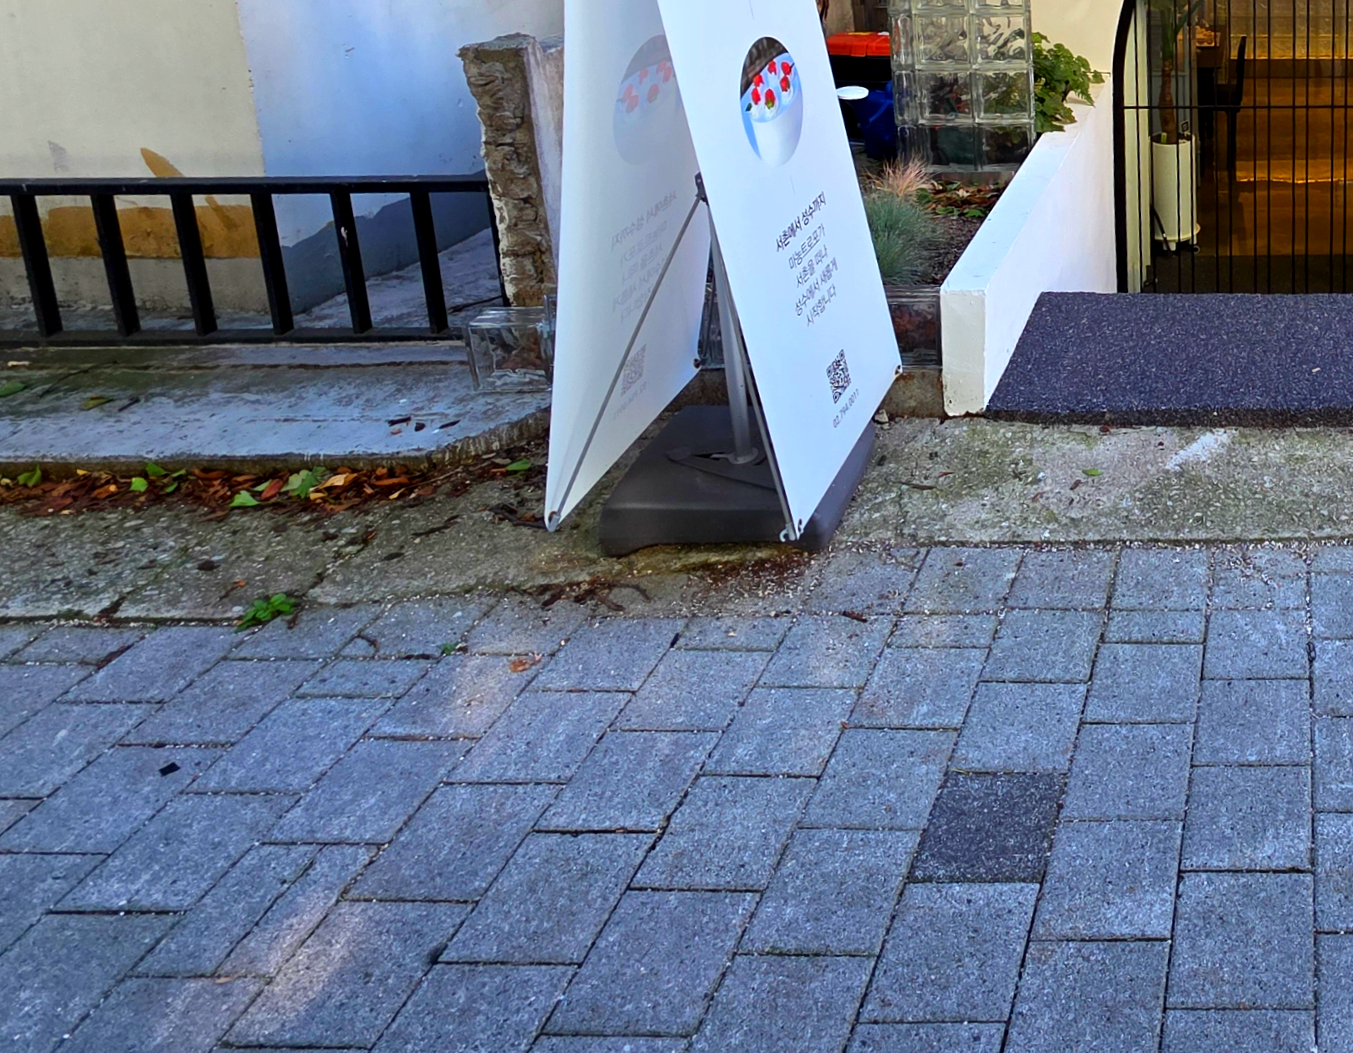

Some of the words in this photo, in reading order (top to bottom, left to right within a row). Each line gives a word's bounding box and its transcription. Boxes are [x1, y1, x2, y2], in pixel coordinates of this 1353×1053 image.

[776, 216, 803, 252] 서촌에서
[801, 191, 827, 226] 성수까지
[788, 223, 826, 269] 마농트로포가
[796, 258, 816, 288] 서촌을
[815, 244, 828, 265] 떠나
[795, 278, 820, 317] 성수에서
[807, 283, 837, 327] 시작합니다
